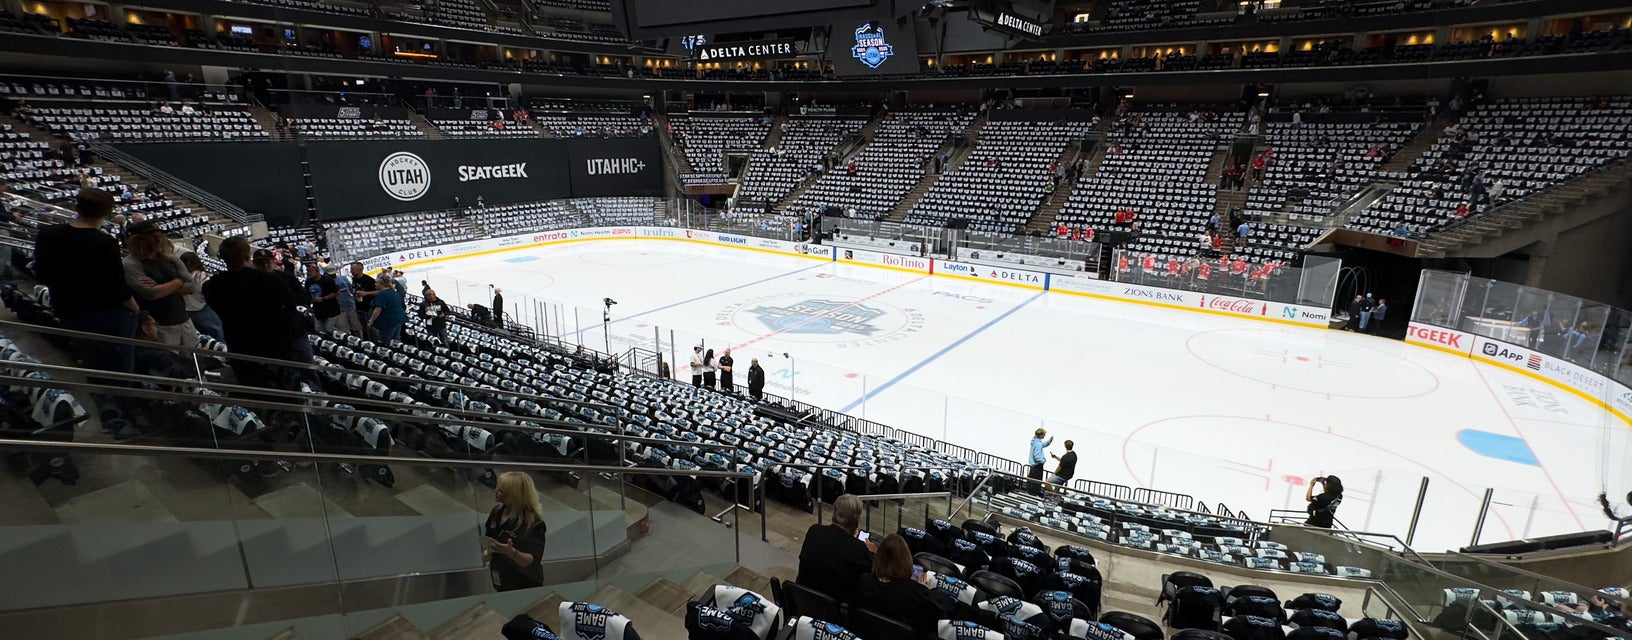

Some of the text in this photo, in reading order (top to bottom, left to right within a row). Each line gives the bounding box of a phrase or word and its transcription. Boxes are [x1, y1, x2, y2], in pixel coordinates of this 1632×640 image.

[1004, 14, 1042, 36] DELTA CENTER
[860, 38, 883, 47] SEASON
[710, 43, 791, 59] DELTA CENTER
[390, 157, 419, 168] HOCKEY
[587, 157, 647, 176] UTAH HC+
[388, 168, 424, 186] UTAH
[458, 162, 528, 182] SEATGEEK
[398, 188, 417, 196] CLUB
[533, 231, 568, 243] entrata
[730, 237, 747, 245] LIGHT
[408, 248, 444, 260] DELTA
[812, 246, 829, 256] Garff
[944, 261, 968, 272] Layton
[1001, 270, 1039, 284] DELTA
[1124, 287, 1184, 303] ZIONS BANK
[789, 304, 868, 325] SEASON
[1301, 310, 1327, 321] Nomi
[1408, 325, 1464, 349] TGEEK
[1544, 361, 1572, 377] BLACK
[1573, 372, 1604, 390] DESERT
[938, 579, 959, 595] GAME
[1051, 600, 1072, 611] GAME
[577, 611, 606, 627] GAME
[957, 626, 984, 638] GAME
[1004, 620, 1028, 636] GAME
[1089, 624, 1117, 640] GAME
